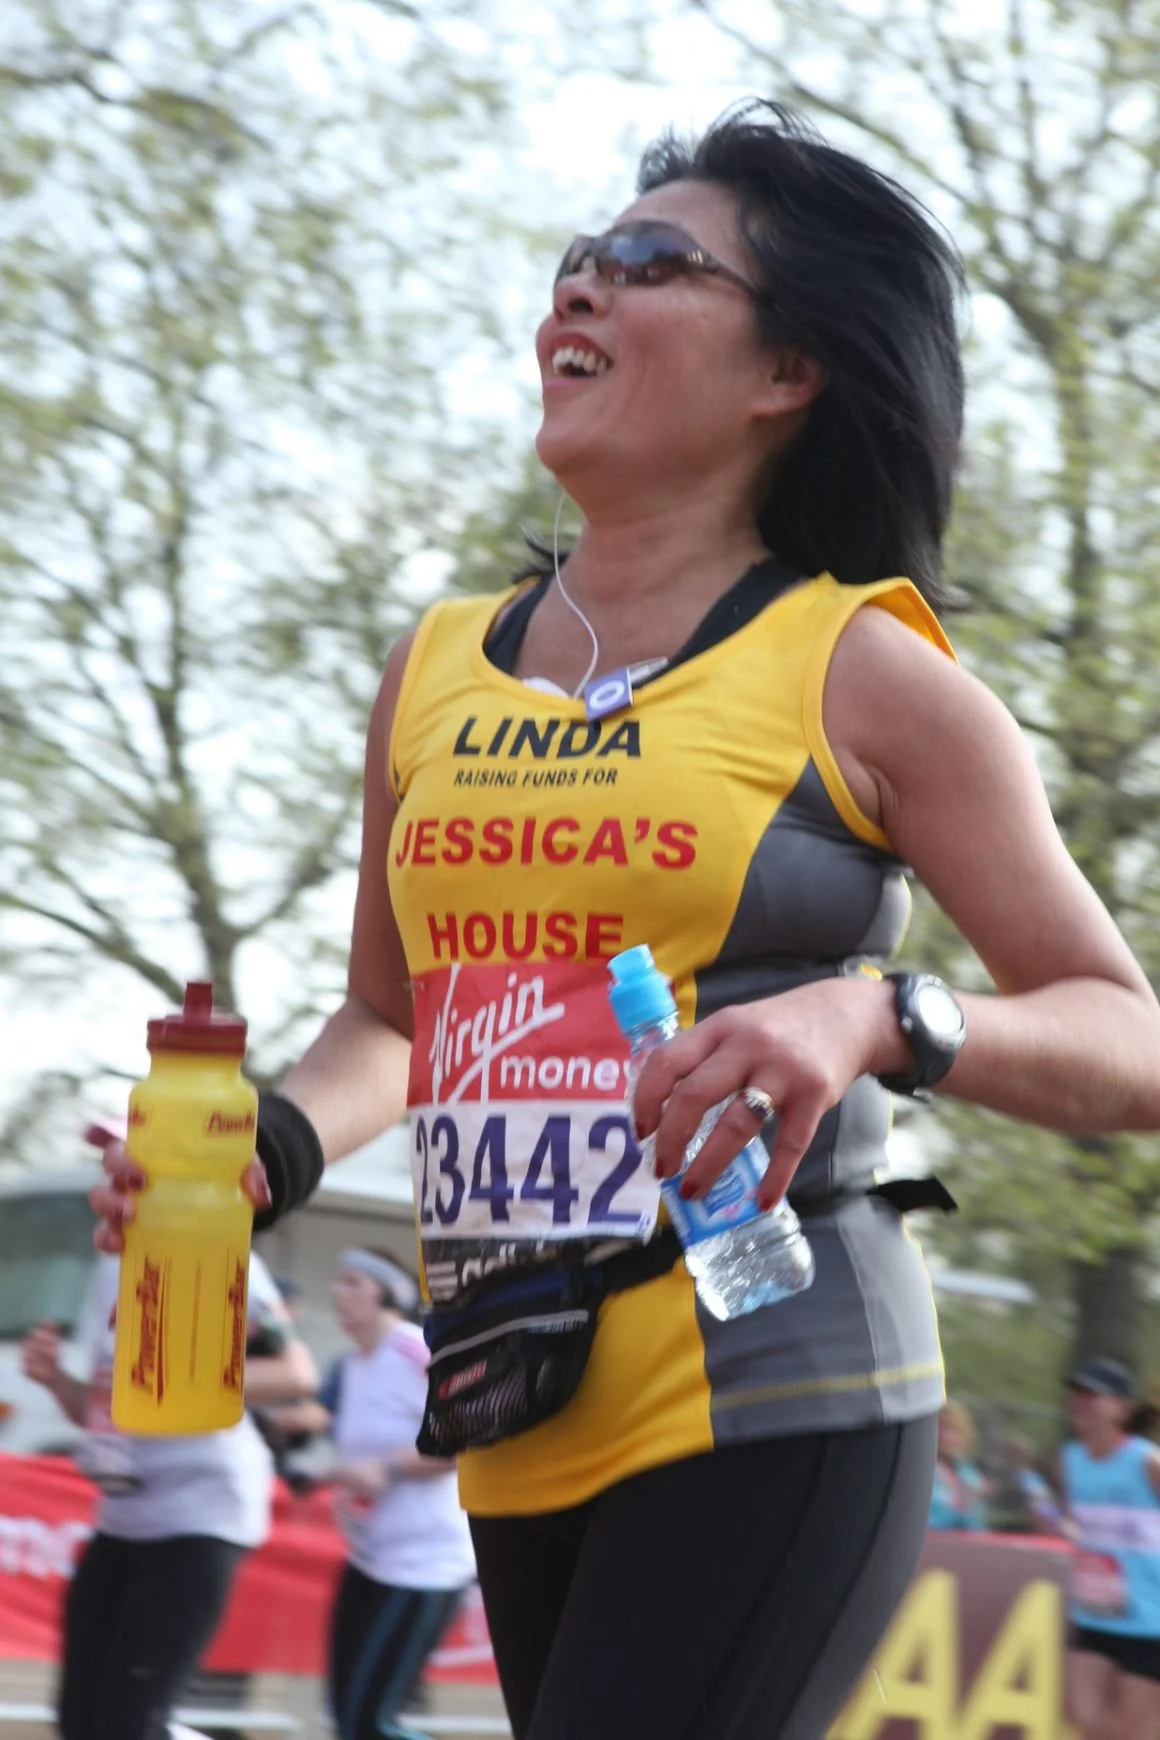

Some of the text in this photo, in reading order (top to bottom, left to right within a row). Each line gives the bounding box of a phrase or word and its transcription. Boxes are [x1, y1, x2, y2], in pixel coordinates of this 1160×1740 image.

[453, 716, 642, 759] LINDA
[454, 767, 619, 788] RAISING FUNDS FOR
[395, 815, 699, 871] JESSICA'S
[426, 911, 624, 961] HOUSE
[428, 962, 566, 1106] Virgin
[415, 1112, 643, 1226] 23442
